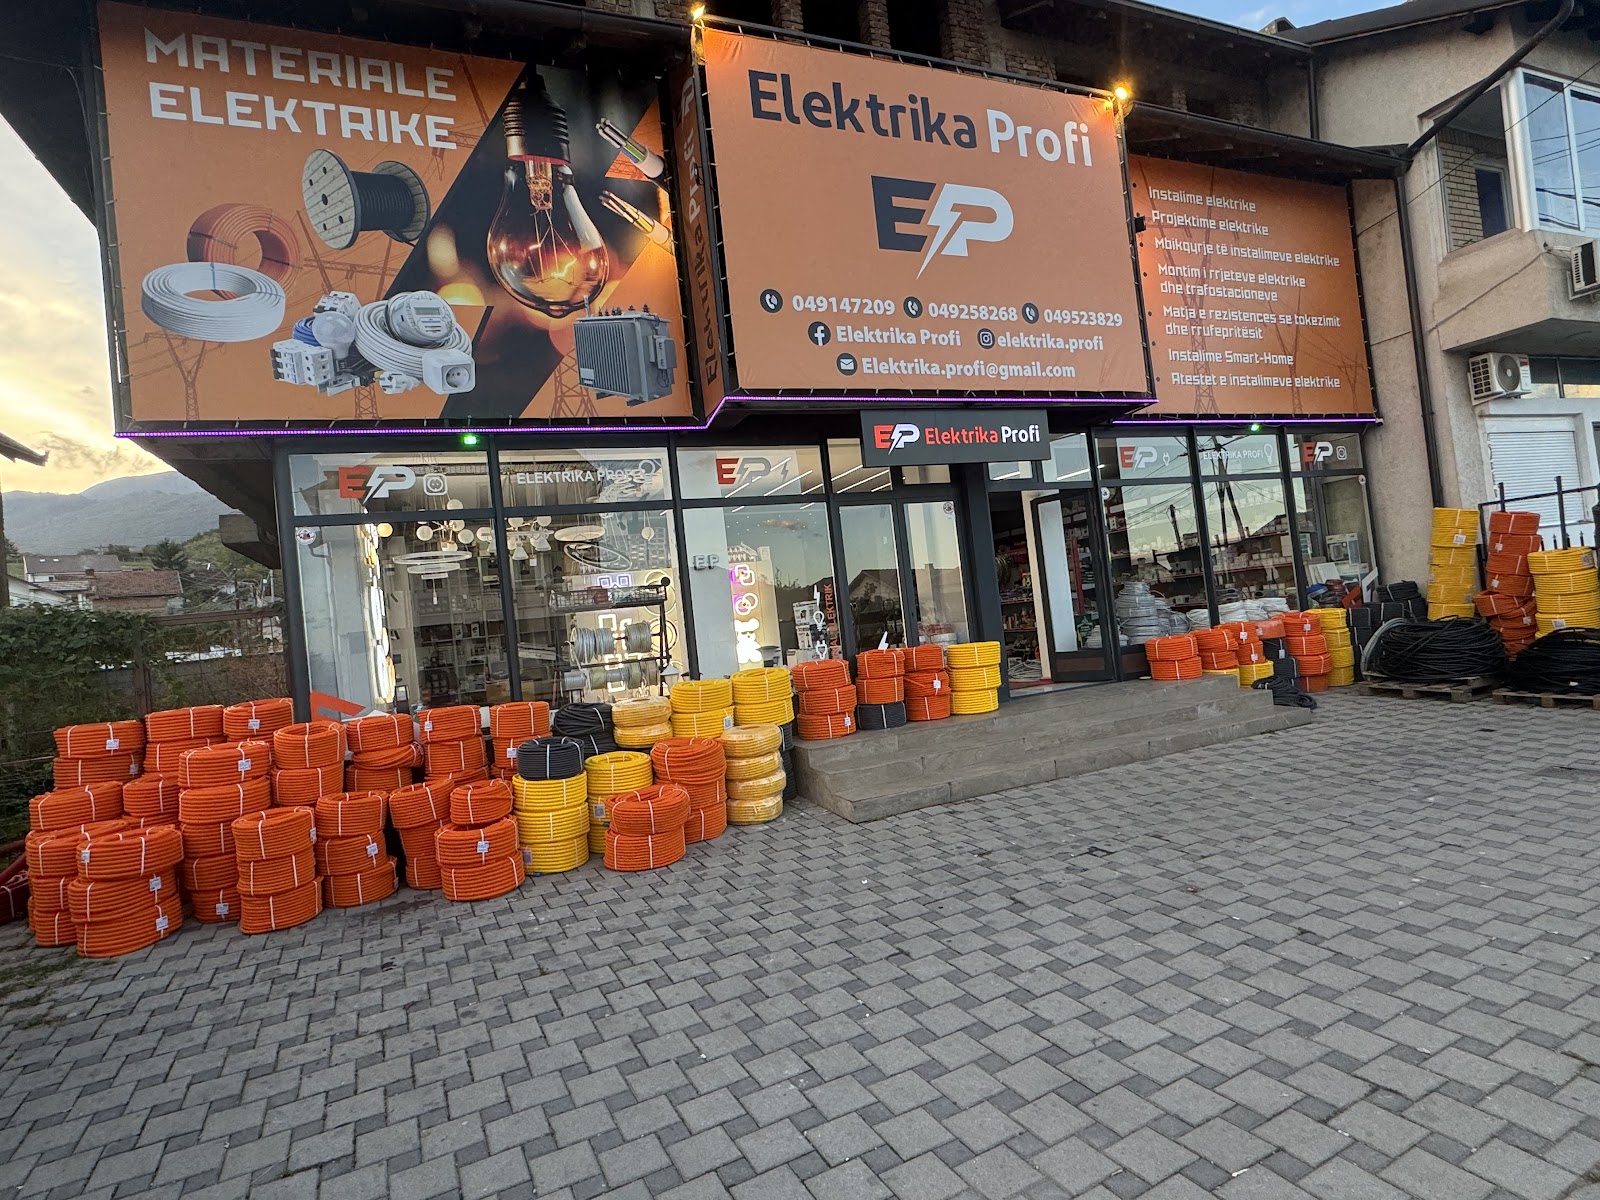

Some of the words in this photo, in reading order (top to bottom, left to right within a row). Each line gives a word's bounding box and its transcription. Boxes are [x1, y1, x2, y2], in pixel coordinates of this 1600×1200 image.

[145, 26, 457, 101] MATERIALE
[149, 82, 457, 150] ELEKTRIKE
[748, 69, 977, 149] Elektrika
[986, 108, 1093, 167] Profi
[1149, 186, 1203, 205] Instalime
[1206, 195, 1257, 212] elektrike
[871, 175, 1014, 280] EP
[1152, 209, 1217, 229] Projektime
[1219, 219, 1269, 236] elektrike
[1154, 237, 1214, 255] Mbikqyrje
[1216, 243, 1228, 255] të
[1230, 244, 1293, 262] instalimeve
[1294, 252, 1340, 267] elektrike
[1157, 262, 1200, 278] Montim
[1203, 266, 1207, 279] i
[1209, 268, 1256, 282] rrjeteve
[1258, 272, 1306, 287] elektrike
[1160, 281, 1183, 294] dhe
[1186, 283, 1278, 302] trafostacioneve
[792, 295, 896, 315] 049147209
[928, 302, 1018, 321] 049258268
[1043, 309, 1123, 327] 049523829
[1163, 304, 1196, 320] Matja
[1199, 309, 1207, 319] e
[836, 325, 917, 344] Elektrika
[920, 329, 961, 346] Profi
[997, 331, 1104, 352] elektrika.profi
[1165, 322, 1188, 335] dhe
[1191, 324, 1264, 340] rrufepritësit
[862, 357, 1076, 380] Elektrika.profi@gmail.com
[1168, 348, 1222, 363] Instalime
[1225, 350, 1294, 365] Smart-Home
[1171, 372, 1217, 386] Atestet
[1219, 376, 1228, 386] e
[1229, 374, 1293, 387] instalimeve
[1295, 376, 1341, 388] elektrike
[873, 423, 920, 455] EP
[924, 425, 999, 445] Elektrika
[1001, 424, 1040, 443] Profi
[1119, 446, 1158, 472] EP
[1203, 450, 1242, 460] ELEKTRIKA
[1243, 449, 1264, 459] PROFI
[1302, 441, 1334, 464] EP
[516, 470, 594, 485] ELEKTRIKA
[715, 457, 772, 485] EP
[338, 466, 416, 505] EP
[693, 554, 720, 570] EP
